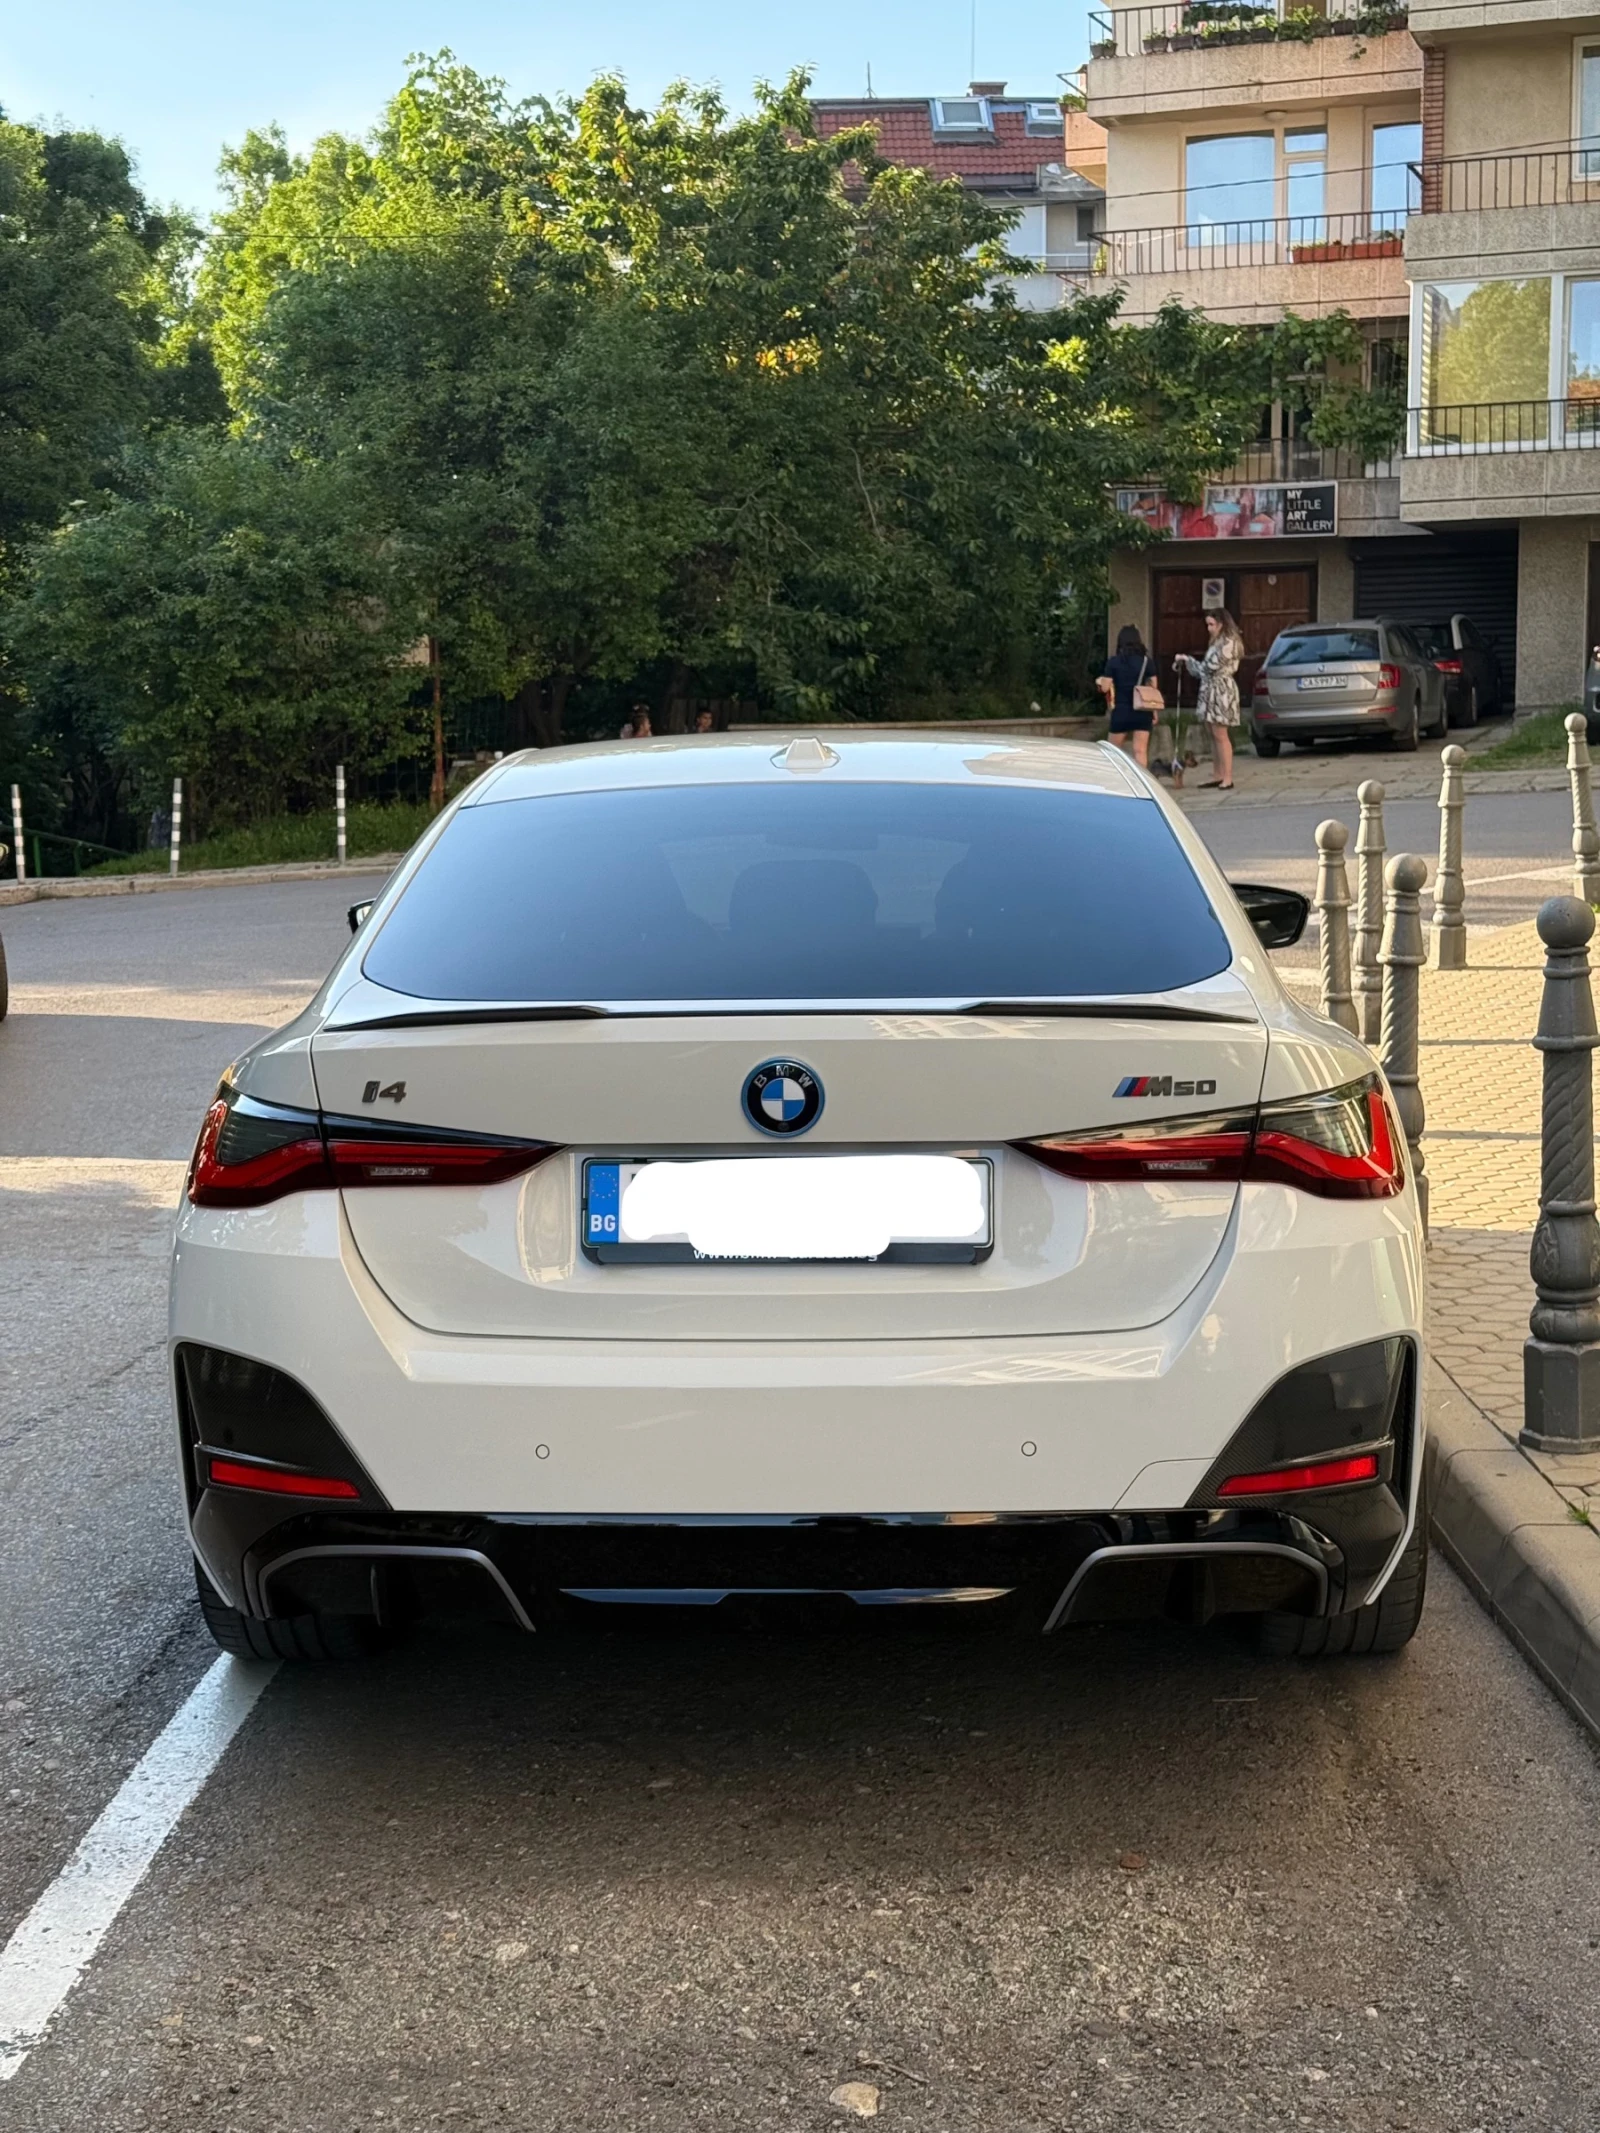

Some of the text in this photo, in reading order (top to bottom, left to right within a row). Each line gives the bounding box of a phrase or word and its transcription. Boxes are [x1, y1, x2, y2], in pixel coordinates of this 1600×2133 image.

[1286, 489, 1302, 500] MY
[1286, 499, 1321, 510] LITTLE
[1286, 510, 1307, 520] ART
[1286, 520, 1333, 531] GALLERY
[753, 1064, 813, 1089] BMW
[361, 1080, 406, 1103] i4
[1141, 1075, 1217, 1097] M50
[590, 1214, 616, 1232] BG
